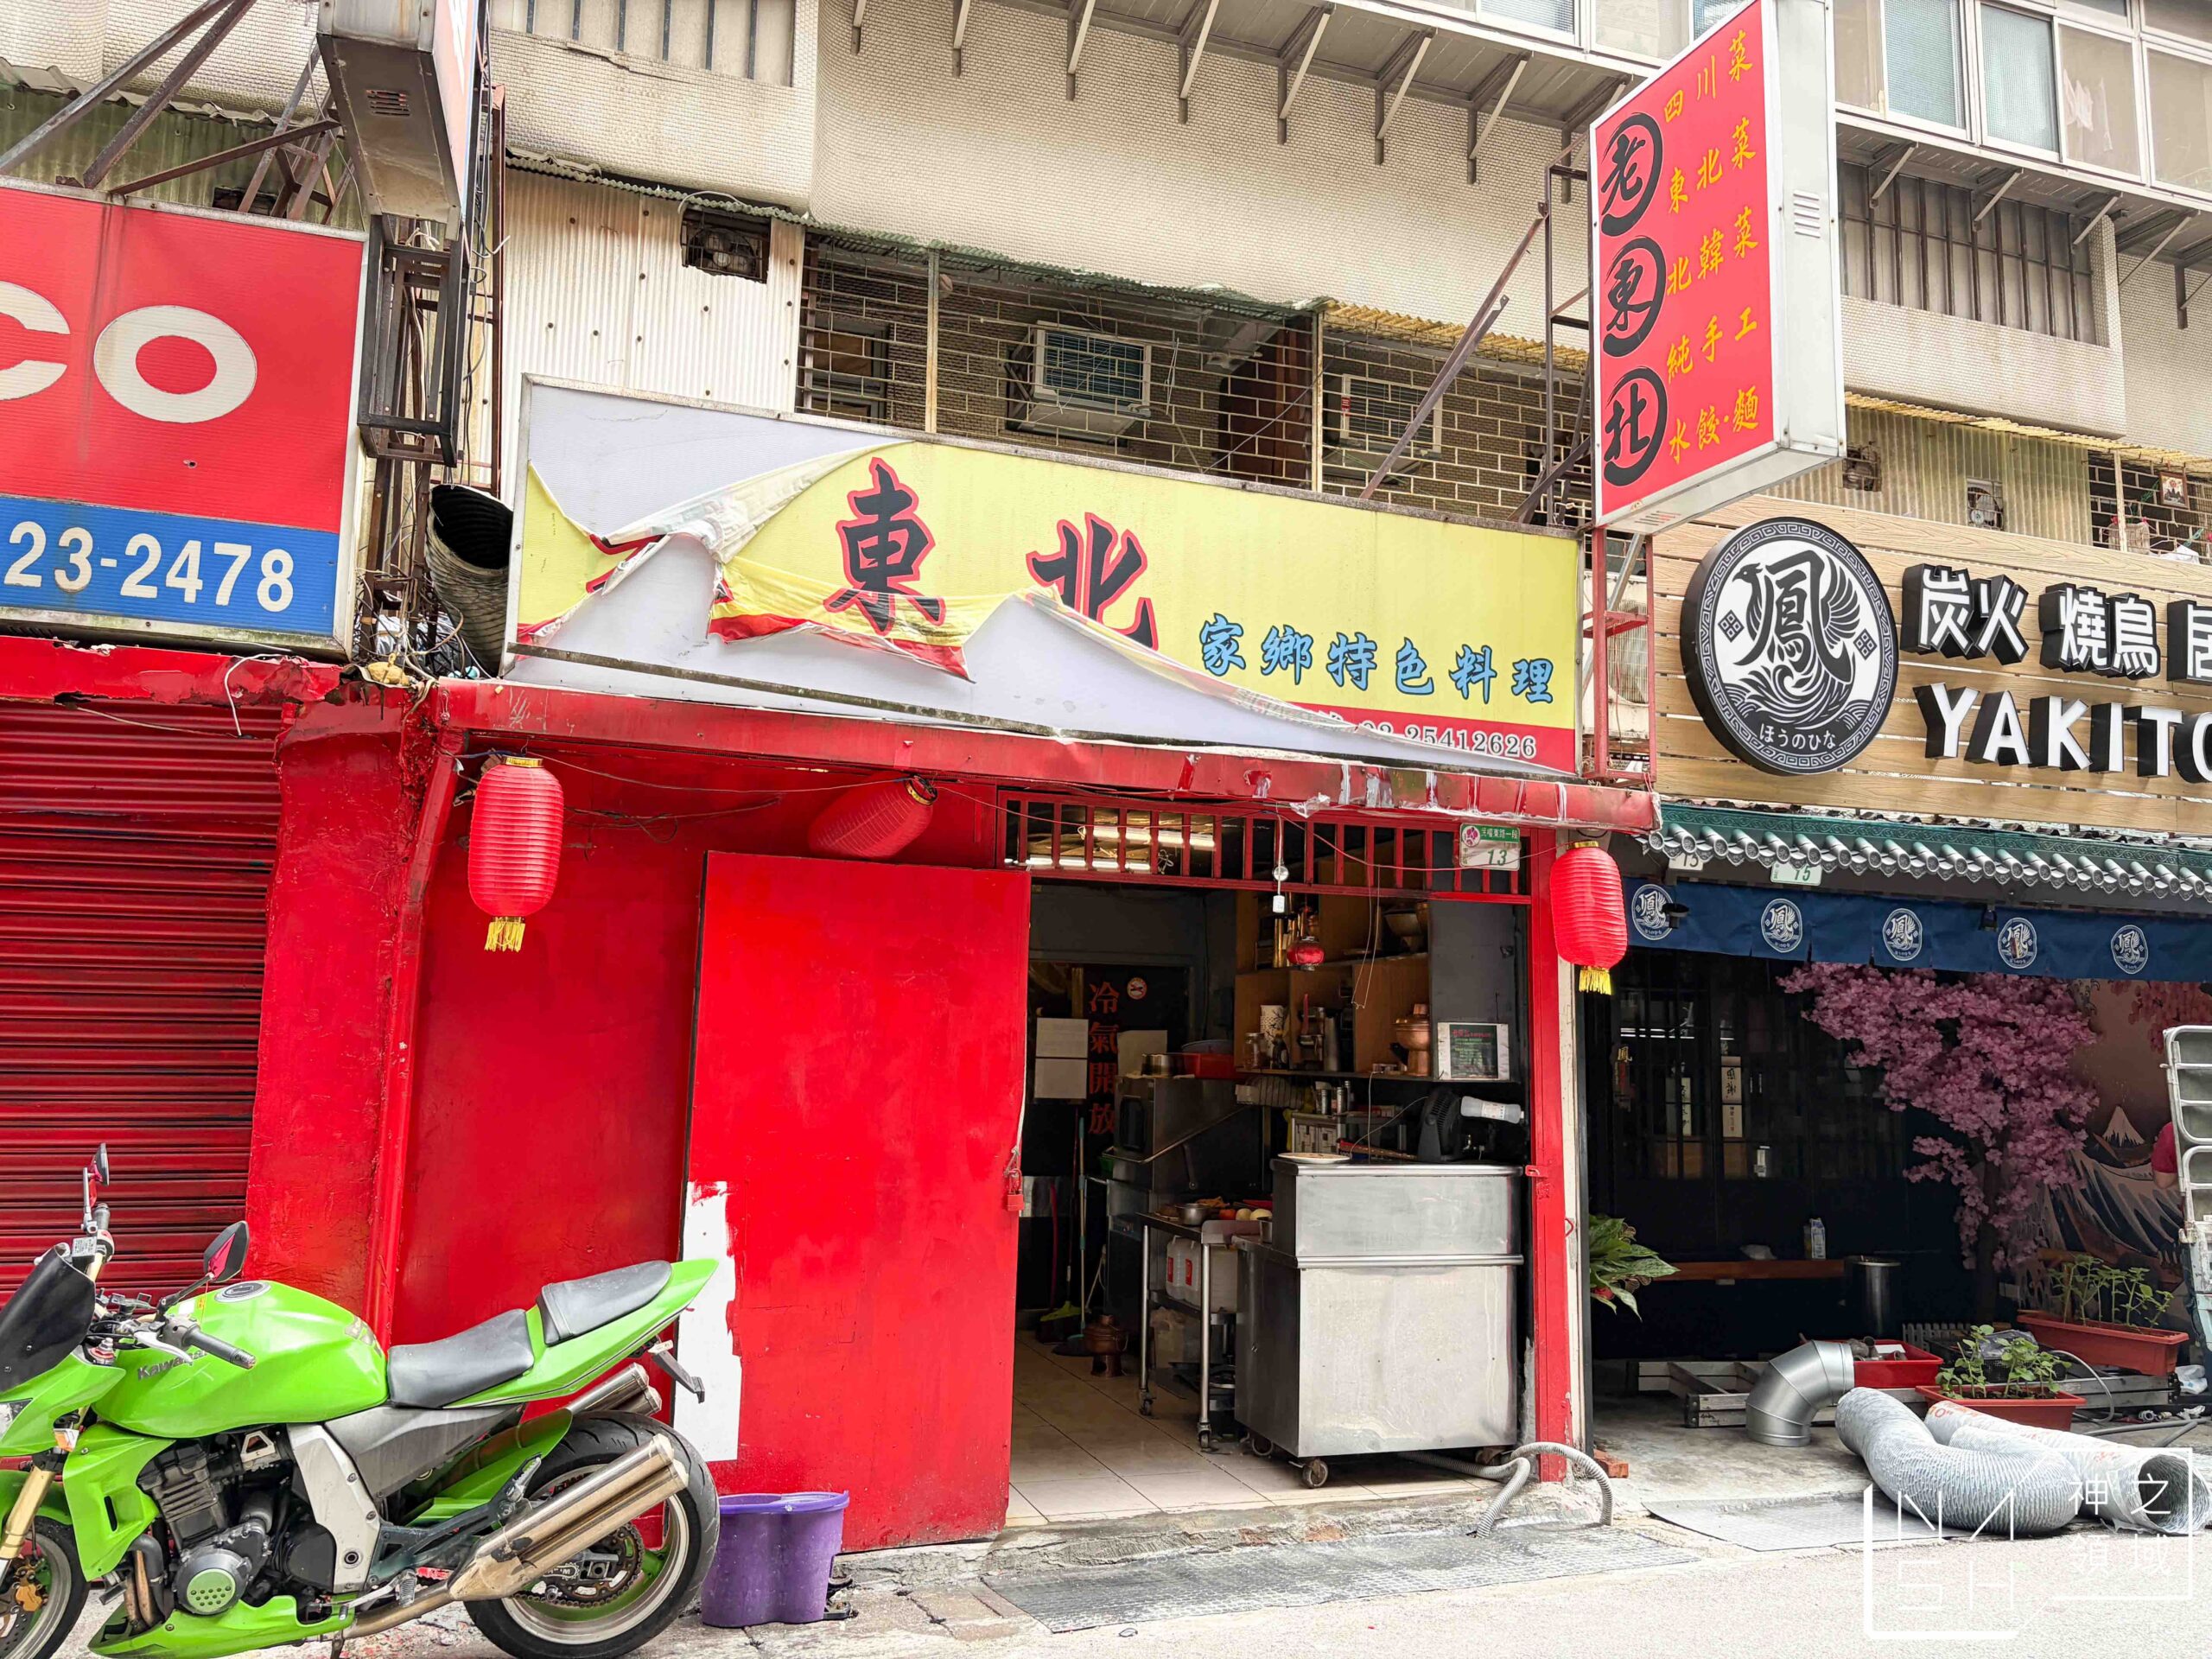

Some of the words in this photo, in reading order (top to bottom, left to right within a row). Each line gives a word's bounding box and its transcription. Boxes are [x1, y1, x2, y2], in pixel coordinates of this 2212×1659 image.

[1663, 29, 1753, 122] 四川菜
[1668, 118, 1757, 215] 東北菜
[1667, 205, 1759, 297] 北韓菜
[1600, 134, 1655, 464] 老東北
[1667, 306, 1758, 385] 純手工
[3, 520, 295, 613] 23-2478
[1198, 612, 1555, 704] 家鄉特色料理
[1732, 549, 1853, 683] 鳳
[1917, 564, 2030, 663] 炭火
[2057, 587, 2160, 677] 燒鳥
[1759, 722, 1838, 751] ほうのひな
[1487, 849, 1508, 866] 13
[1088, 981, 1120, 1135] 冷氣開放
